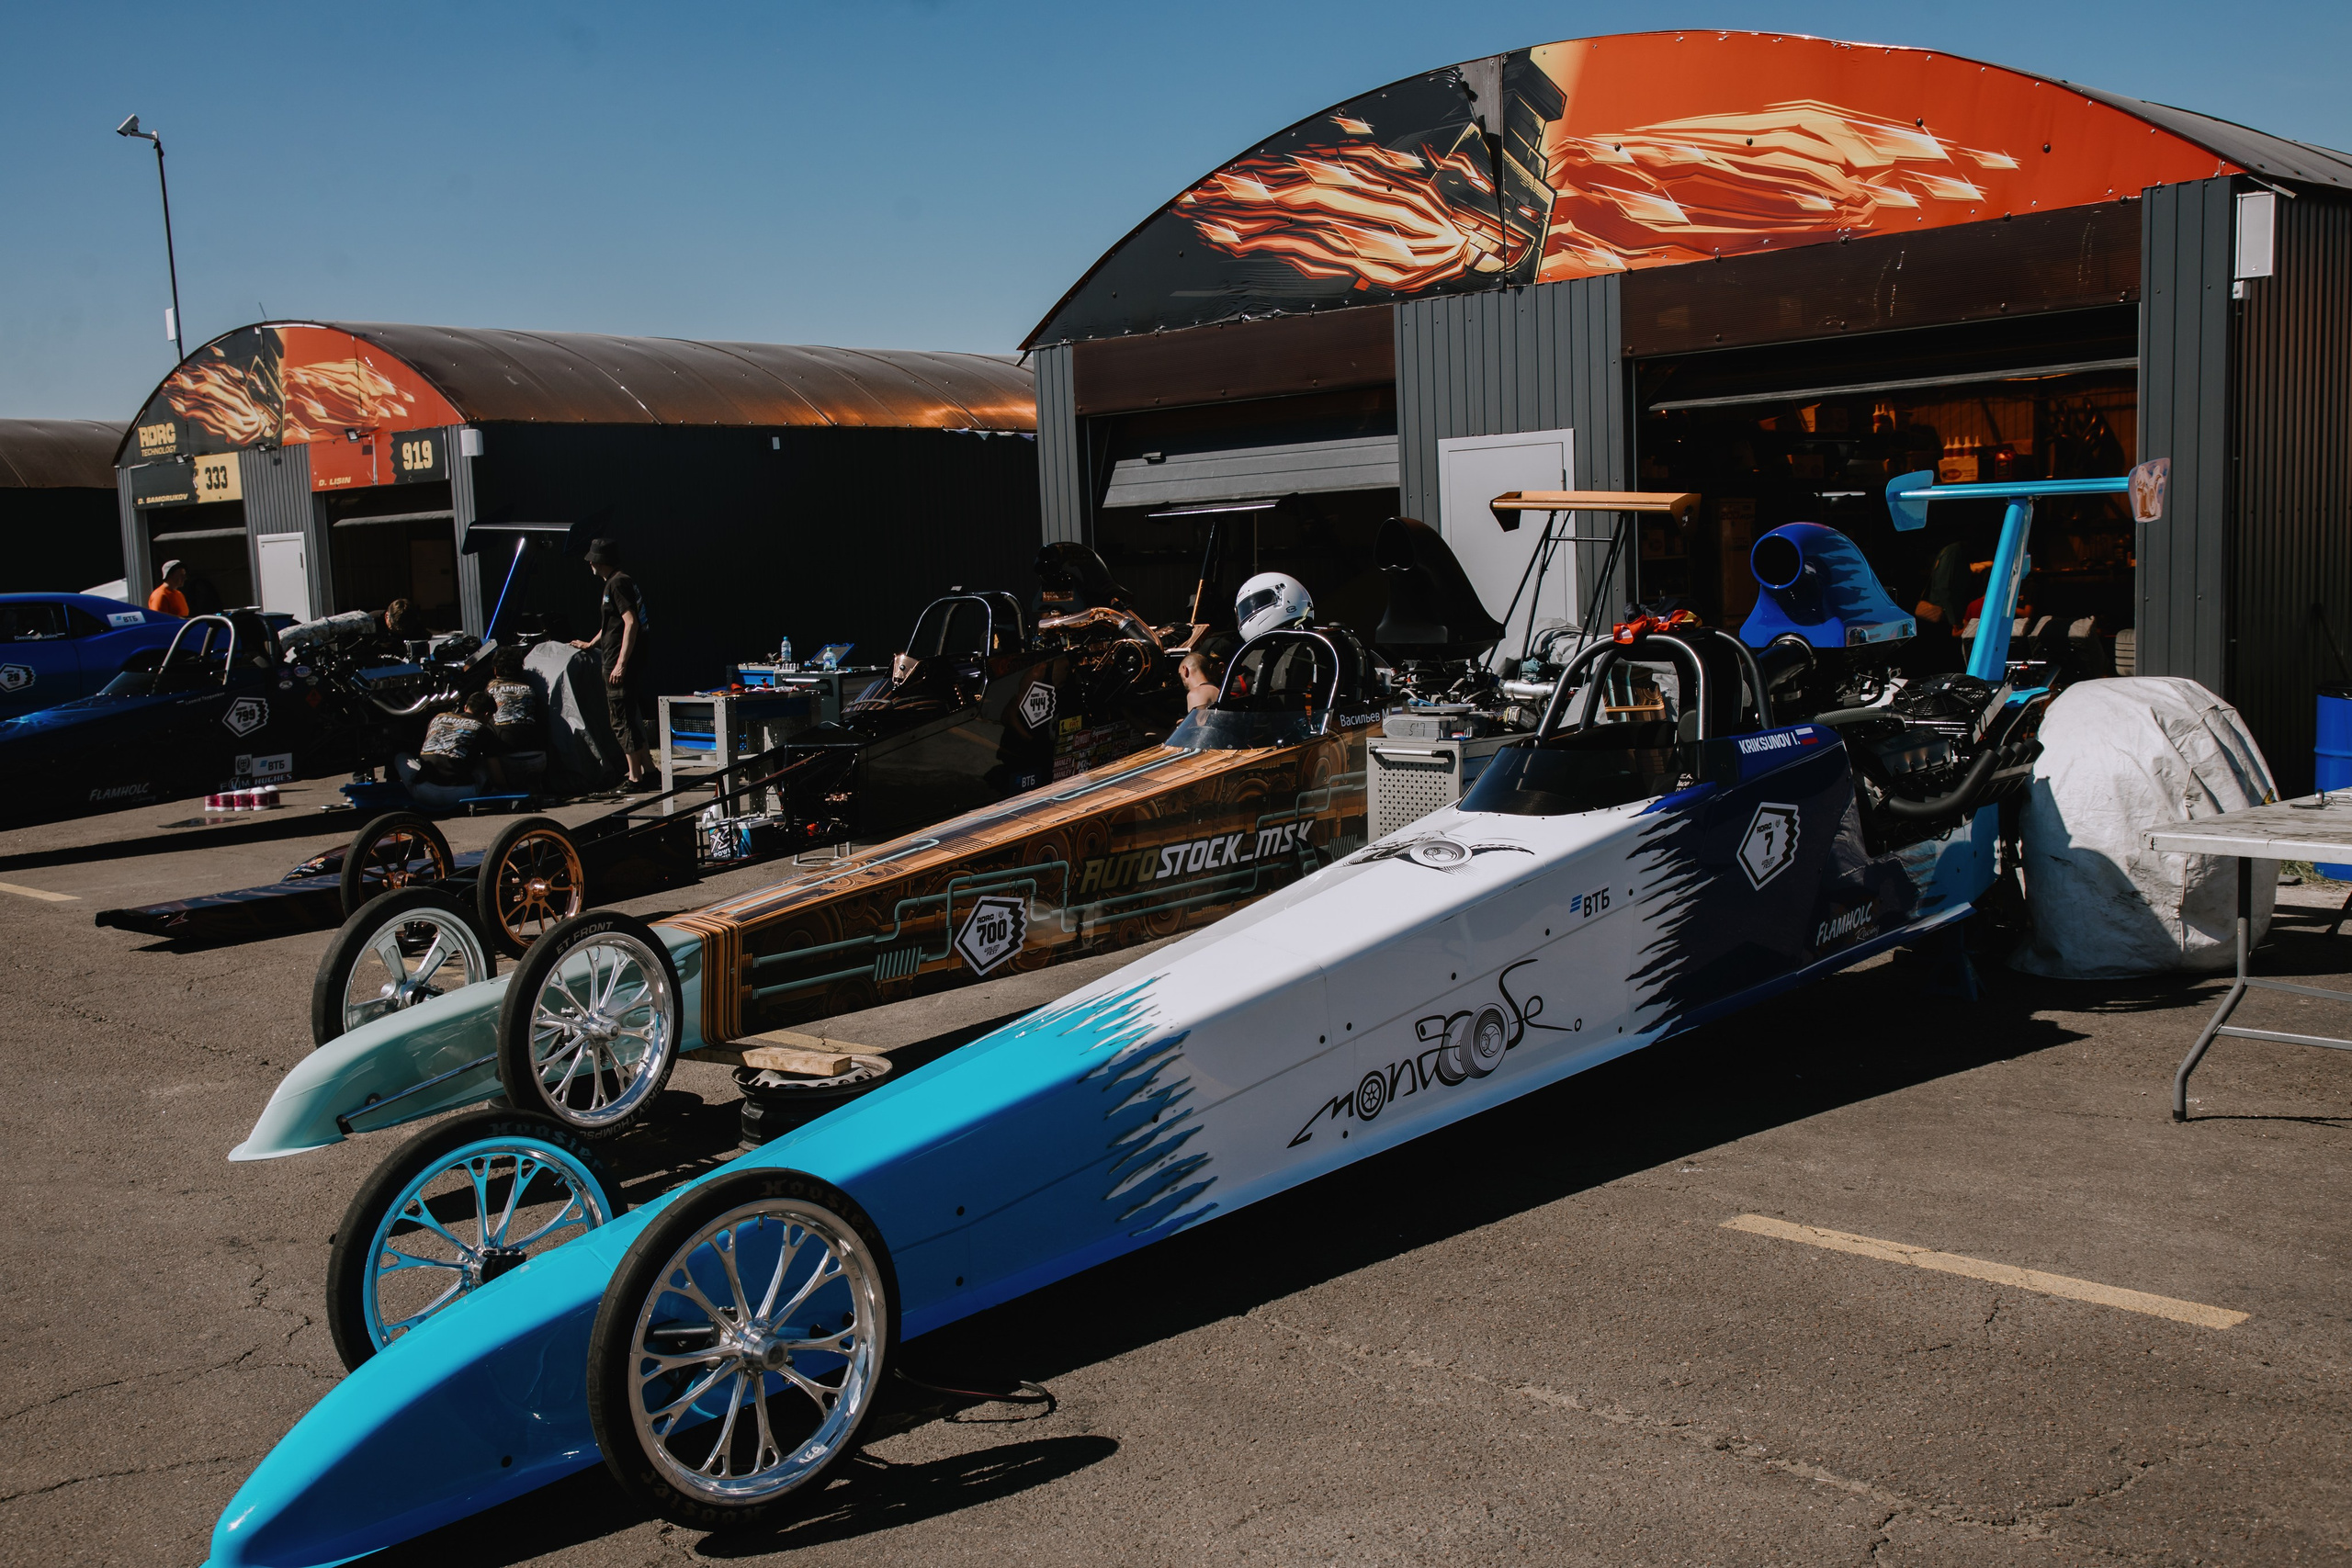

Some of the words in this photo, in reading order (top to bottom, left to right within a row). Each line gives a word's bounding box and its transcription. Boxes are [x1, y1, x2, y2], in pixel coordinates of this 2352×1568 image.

[138, 423, 176, 447] RDRC
[141, 445, 176, 457] TECHNOLOGY
[401, 440, 433, 470] 919
[205, 466, 228, 490] 333
[318, 479, 327, 487] D.
[329, 476, 351, 485] LISIN
[146, 493, 188, 504] SAMORUKOV
[6, 673, 20, 682] 28
[1030, 697, 1046, 712] 444
[235, 709, 255, 723] 799
[1340, 713, 1381, 727] Васильев
[1738, 732, 1792, 754] KRIKSUNOV
[1791, 732, 1801, 746] I.
[267, 760, 285, 771] ВТБ
[1054, 757, 1073, 768] MANLEY
[254, 773, 292, 785] HUGHES
[1022, 774, 1035, 787] ВТБ
[1053, 769, 1073, 780] MANLEY
[89, 782, 150, 802] FLAMHOLC
[1765, 830, 1774, 856] 7
[1080, 820, 1315, 895] AUTOSTOCK_MSK
[1583, 886, 1610, 919] ВТБ
[977, 913, 994, 924] RDRC
[1815, 901, 1872, 946] FLAMHOLC
[555, 937, 570, 954] ET
[572, 921, 614, 942] FRONT
[976, 919, 1007, 947] 700
[638, 1067, 672, 1119] MICKEY
[486, 1121, 604, 1169] Hoosier
[759, 1179, 875, 1241] Hoosier
